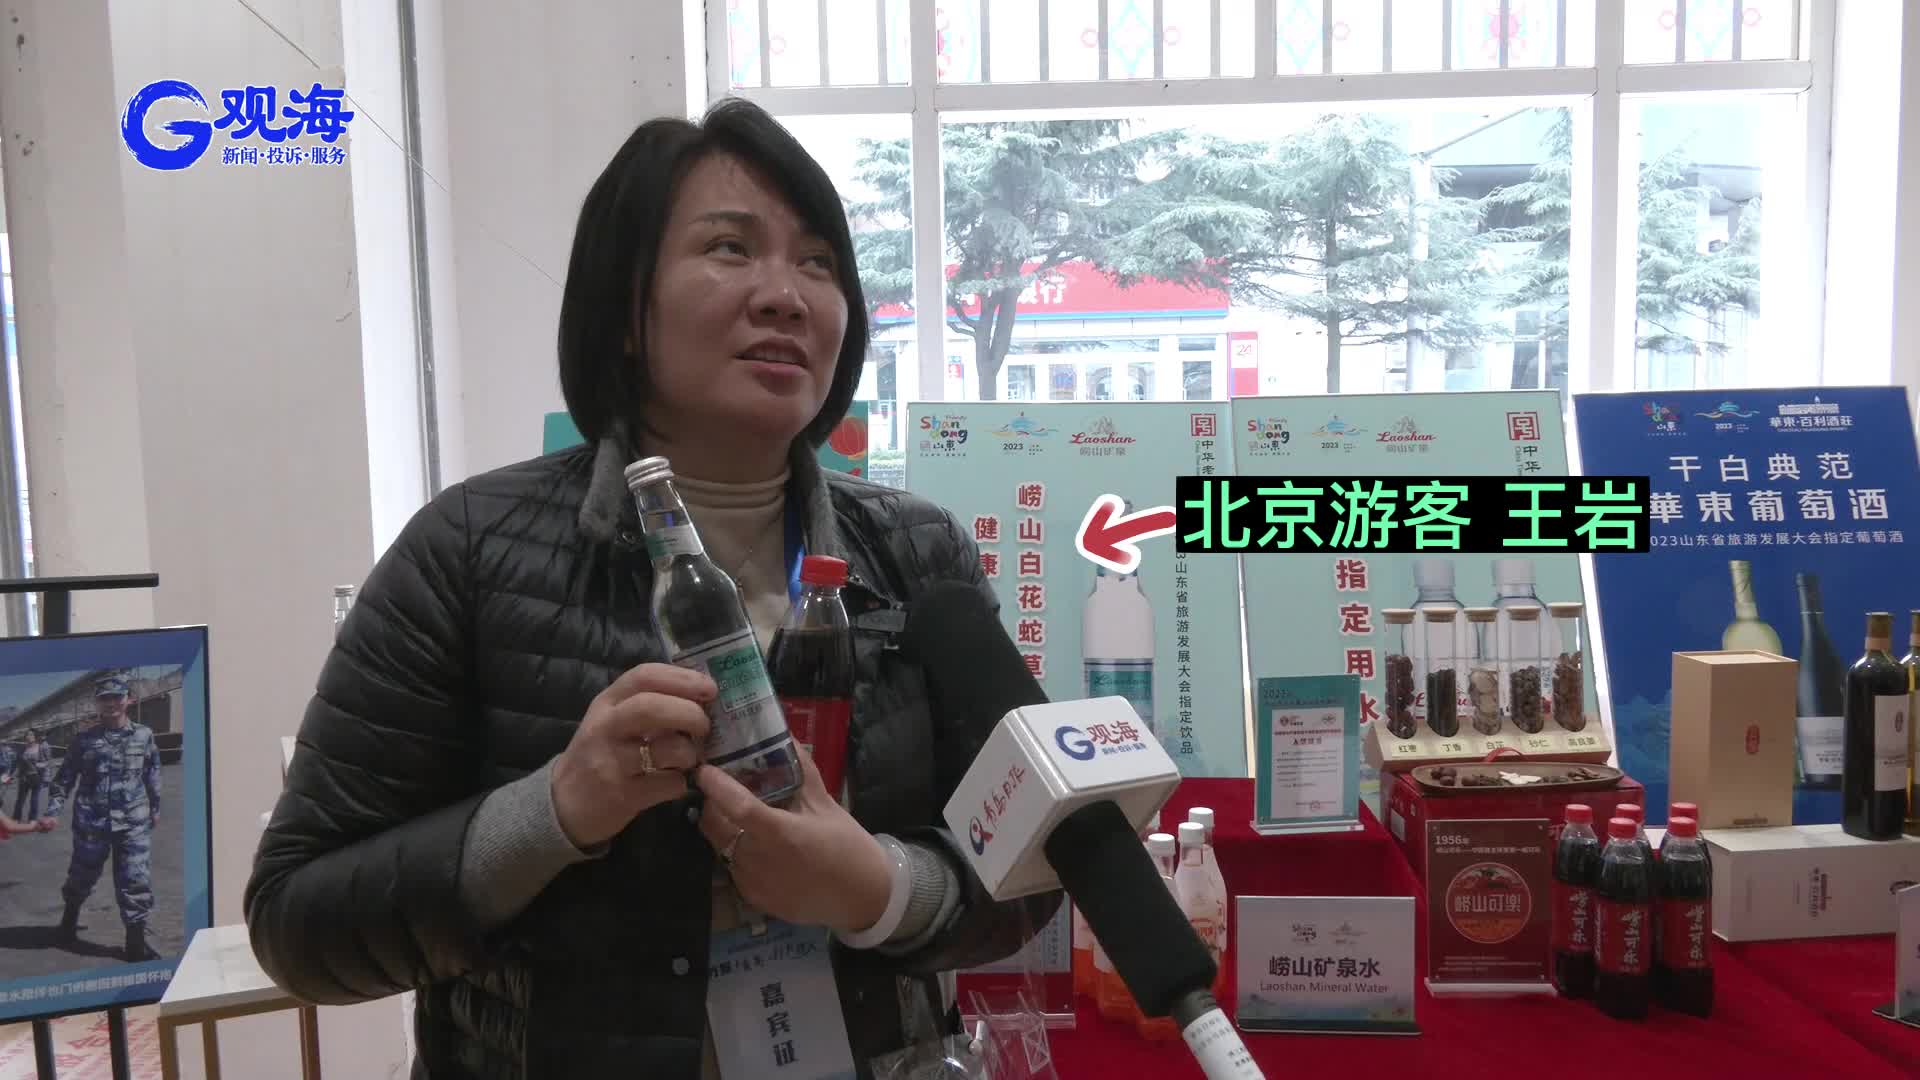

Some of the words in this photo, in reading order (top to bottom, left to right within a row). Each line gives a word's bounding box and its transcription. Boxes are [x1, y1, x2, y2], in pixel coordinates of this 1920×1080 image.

[1269, 956, 1381, 978] 崂山矿泉水
[1260, 981, 1306, 992] Laoshan
[1309, 981, 1352, 993] Mineral
[1356, 982, 1389, 993] Water
